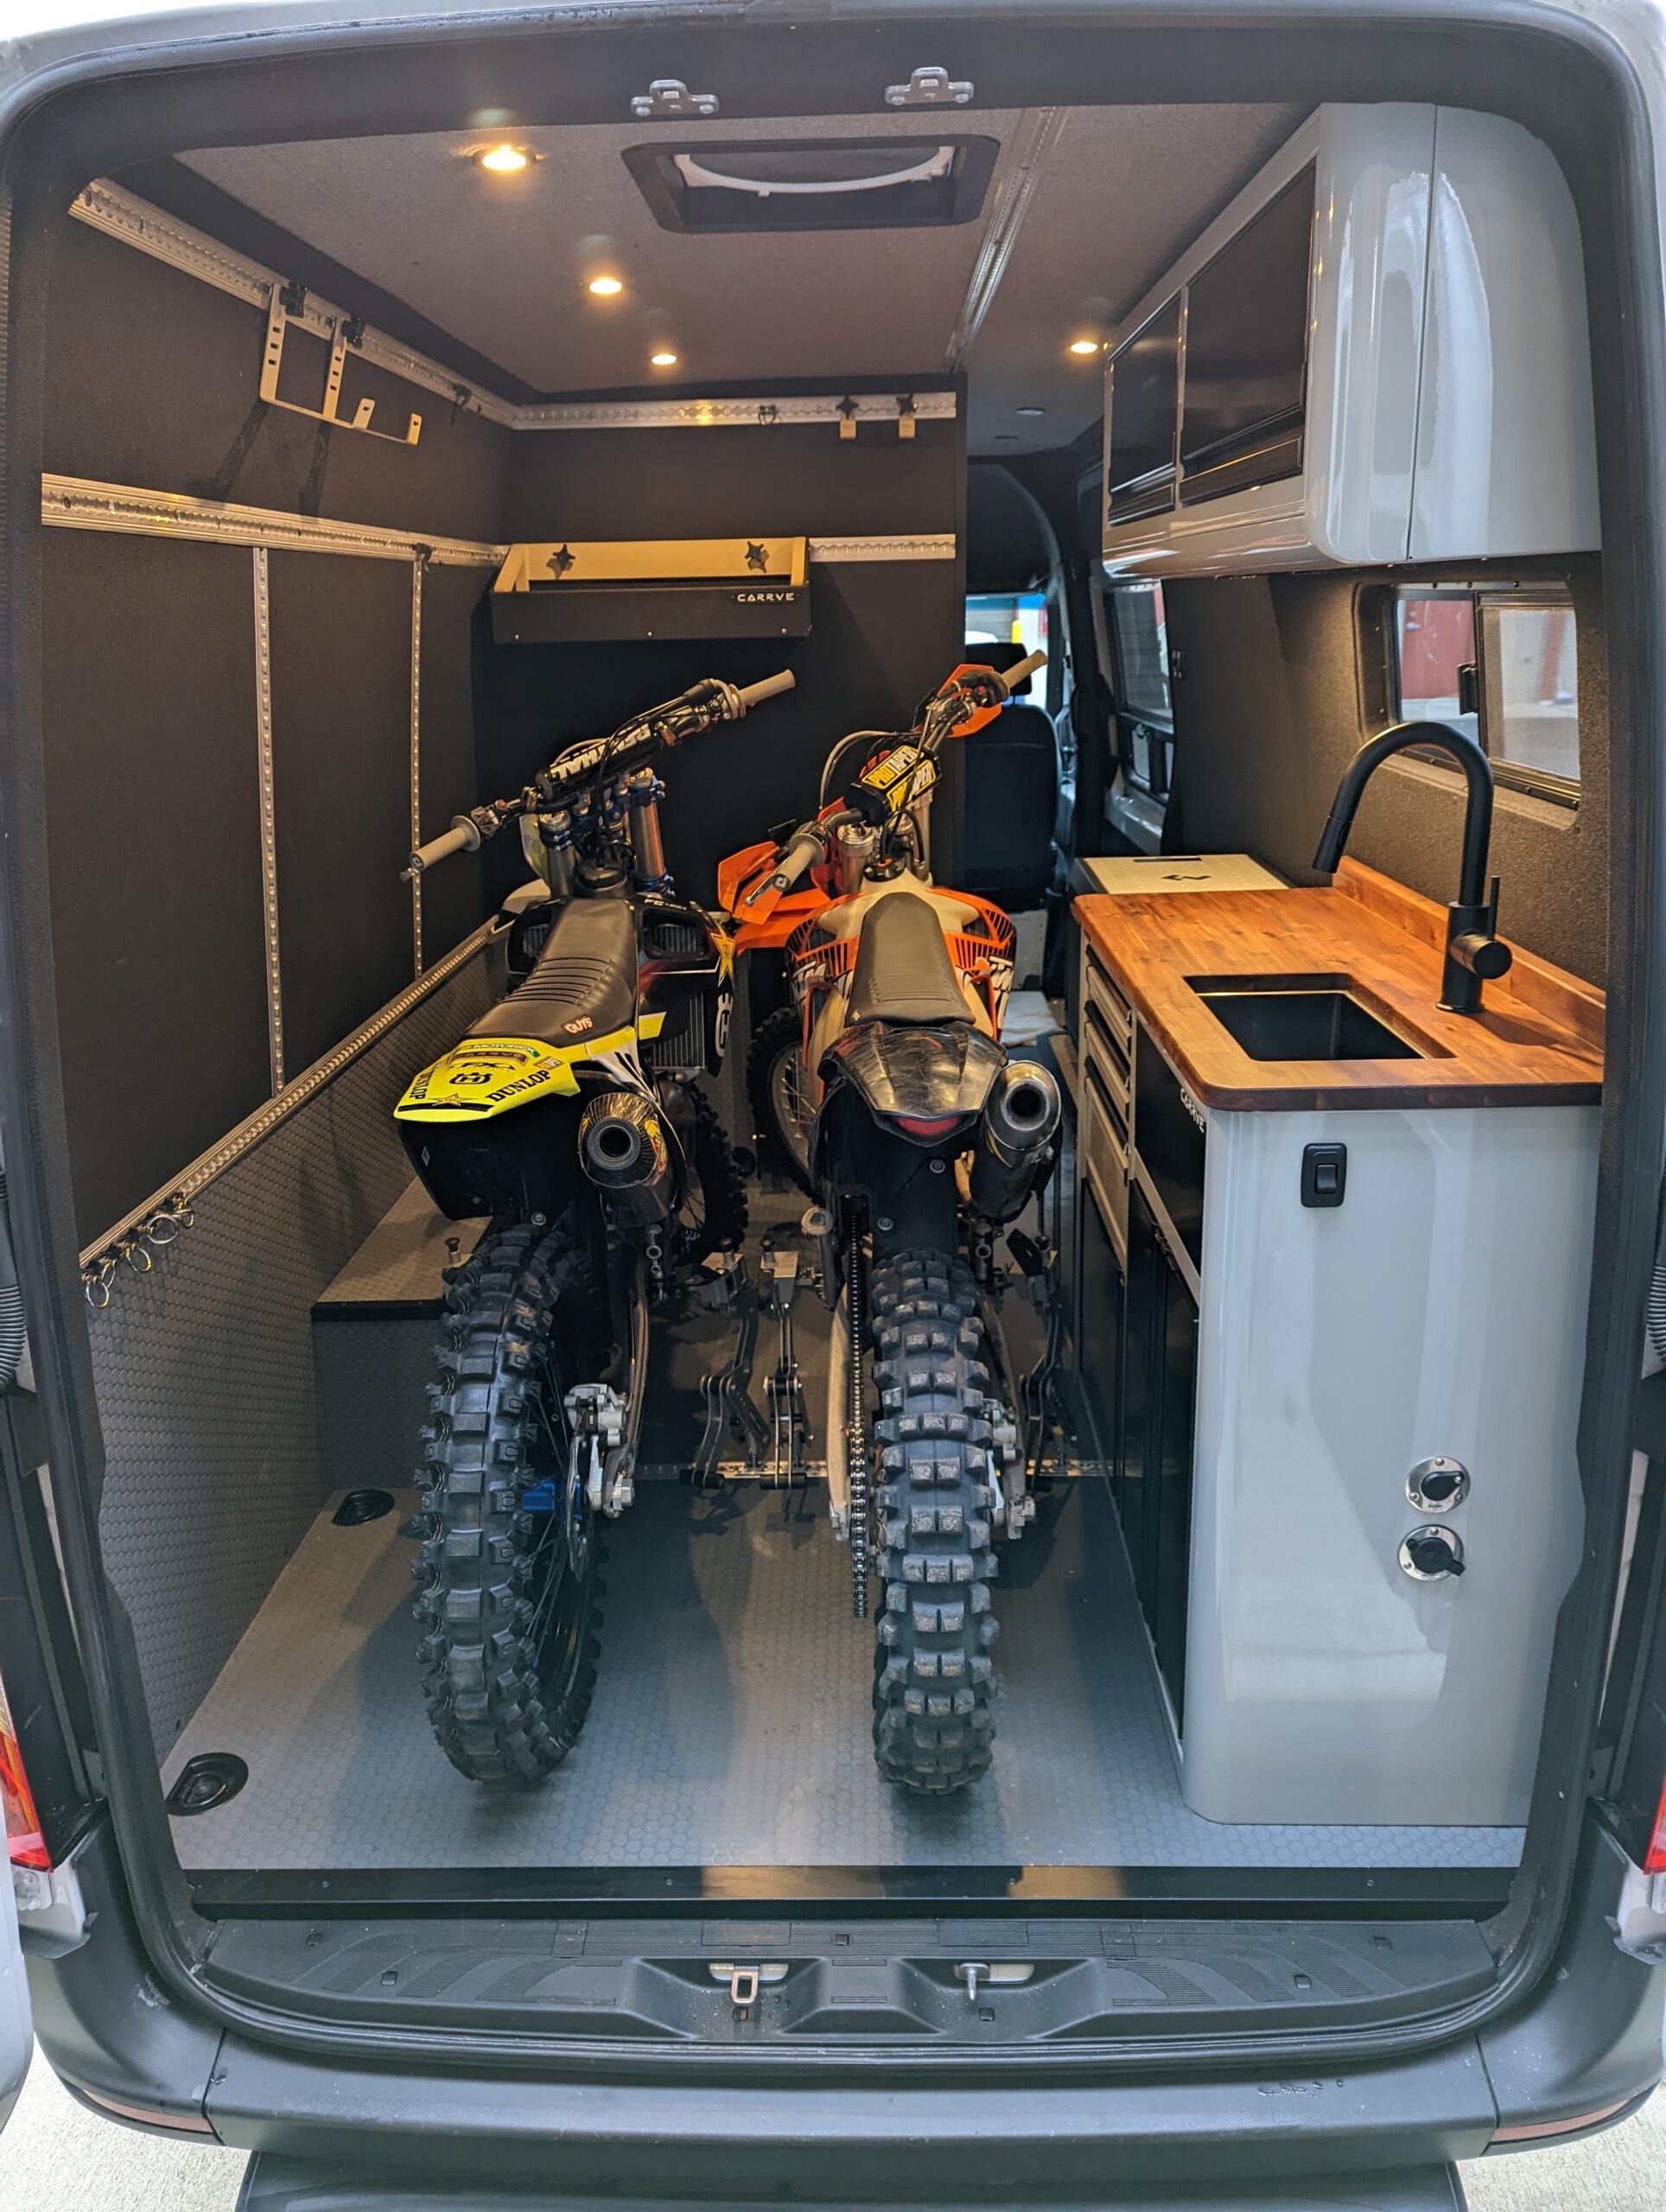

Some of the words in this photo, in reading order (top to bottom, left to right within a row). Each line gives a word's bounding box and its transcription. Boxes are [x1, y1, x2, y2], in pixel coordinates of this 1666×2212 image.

[737, 592, 795, 602] CARRVE
[485, 1070, 551, 1102] DUNLOP
[1180, 1088, 1205, 1134] CARRVE
